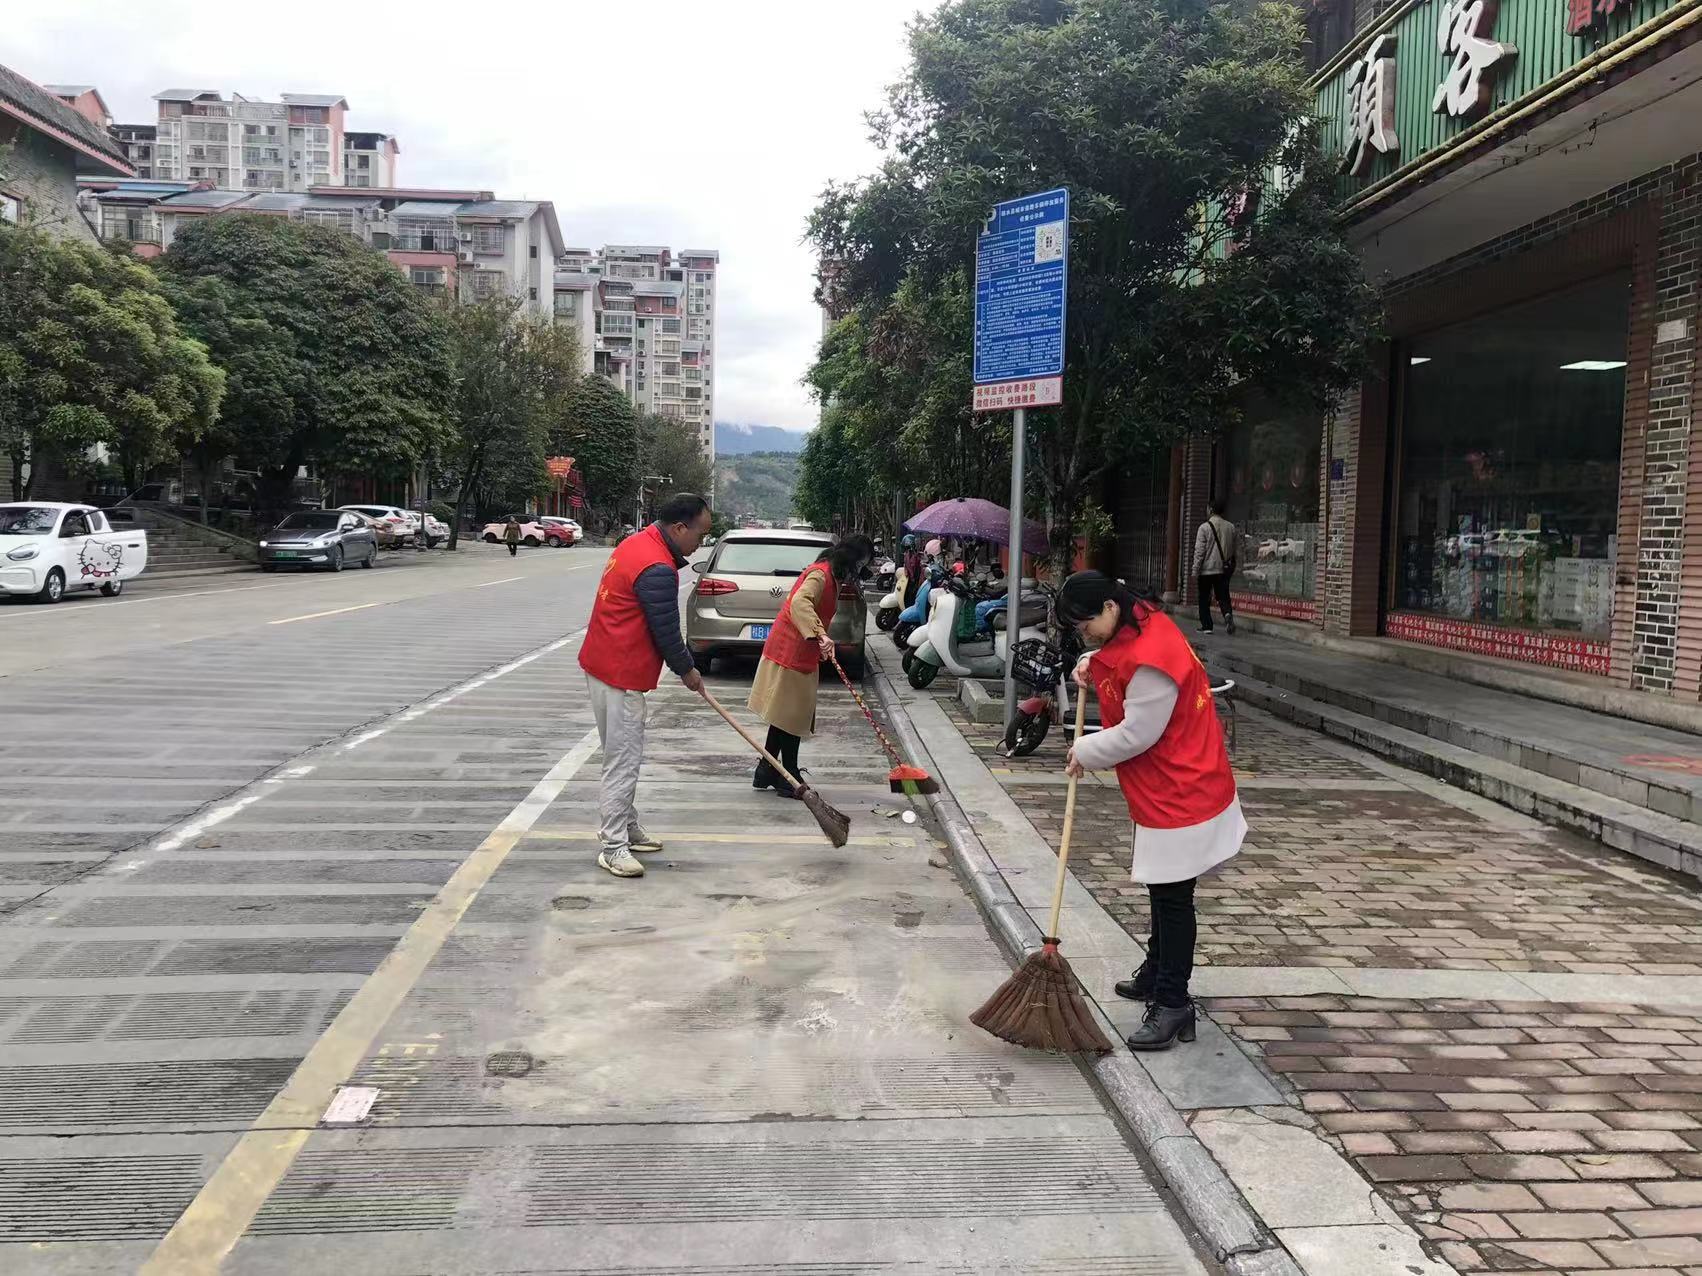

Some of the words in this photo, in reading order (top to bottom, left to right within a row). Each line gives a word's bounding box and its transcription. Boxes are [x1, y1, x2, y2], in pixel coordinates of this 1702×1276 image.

[976, 382, 1036, 396] 视频监控收费路段
